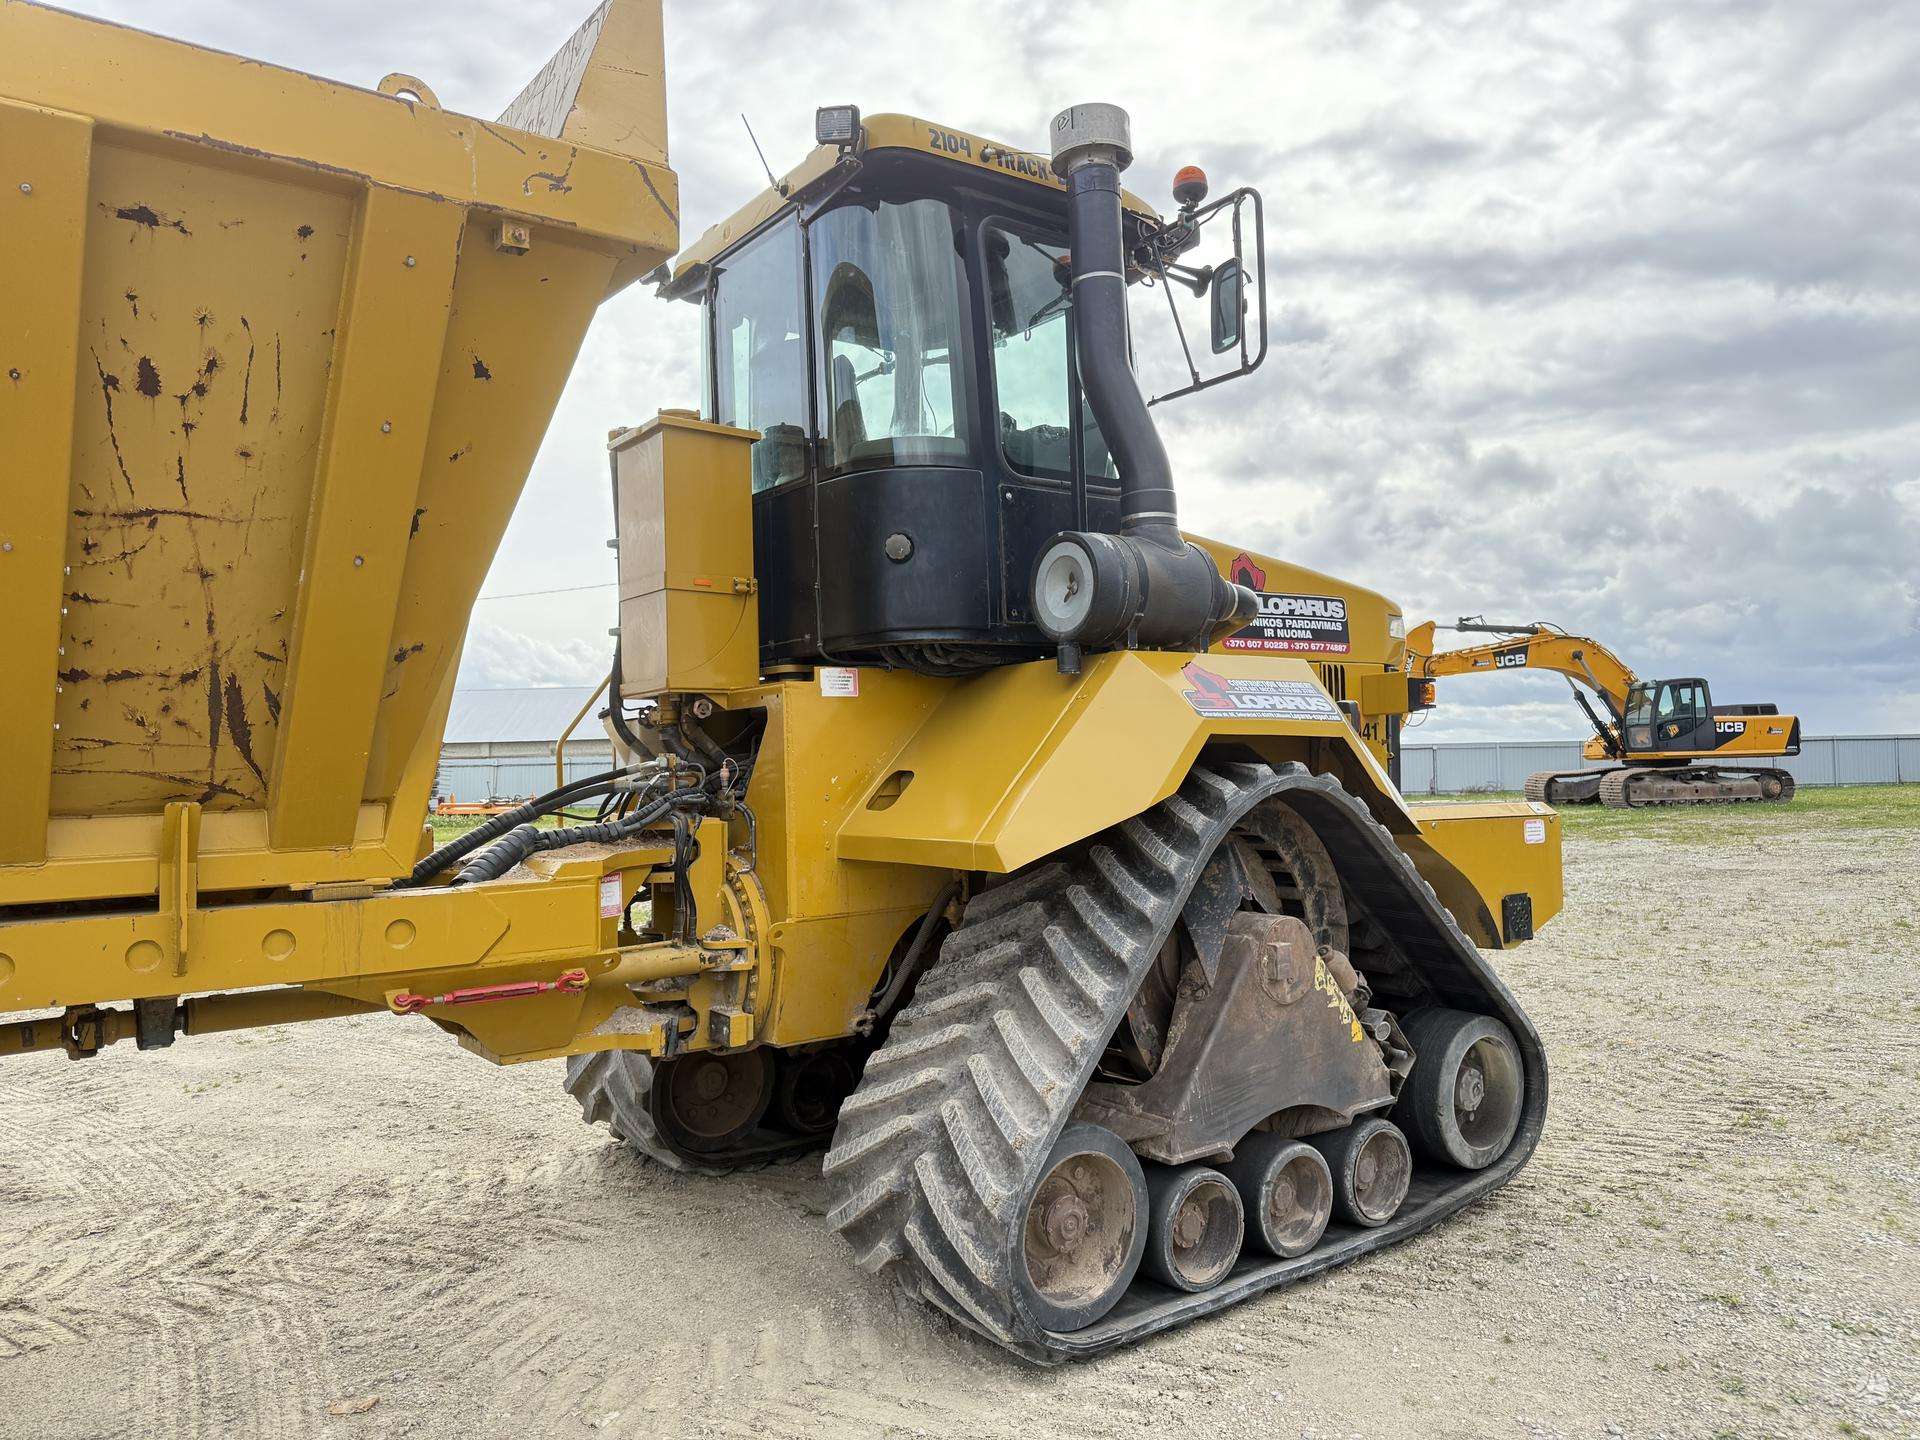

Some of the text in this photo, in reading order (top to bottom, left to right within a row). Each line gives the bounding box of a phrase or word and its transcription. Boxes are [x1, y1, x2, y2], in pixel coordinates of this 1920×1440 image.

[928, 127, 972, 158] 2104
[1257, 596, 1345, 618] LOPARUS
[1249, 618, 1343, 631] NIKOS PARDAVIMAS
[1264, 628, 1313, 639] IR NUOMA
[1225, 639, 1246, 648] +370
[1290, 642, 1309, 650] +370
[1494, 653, 1527, 668] JCB
[1228, 694, 1332, 711] LOPARUS
[1359, 721, 1379, 741] 41
[1715, 721, 1745, 733] JCB
